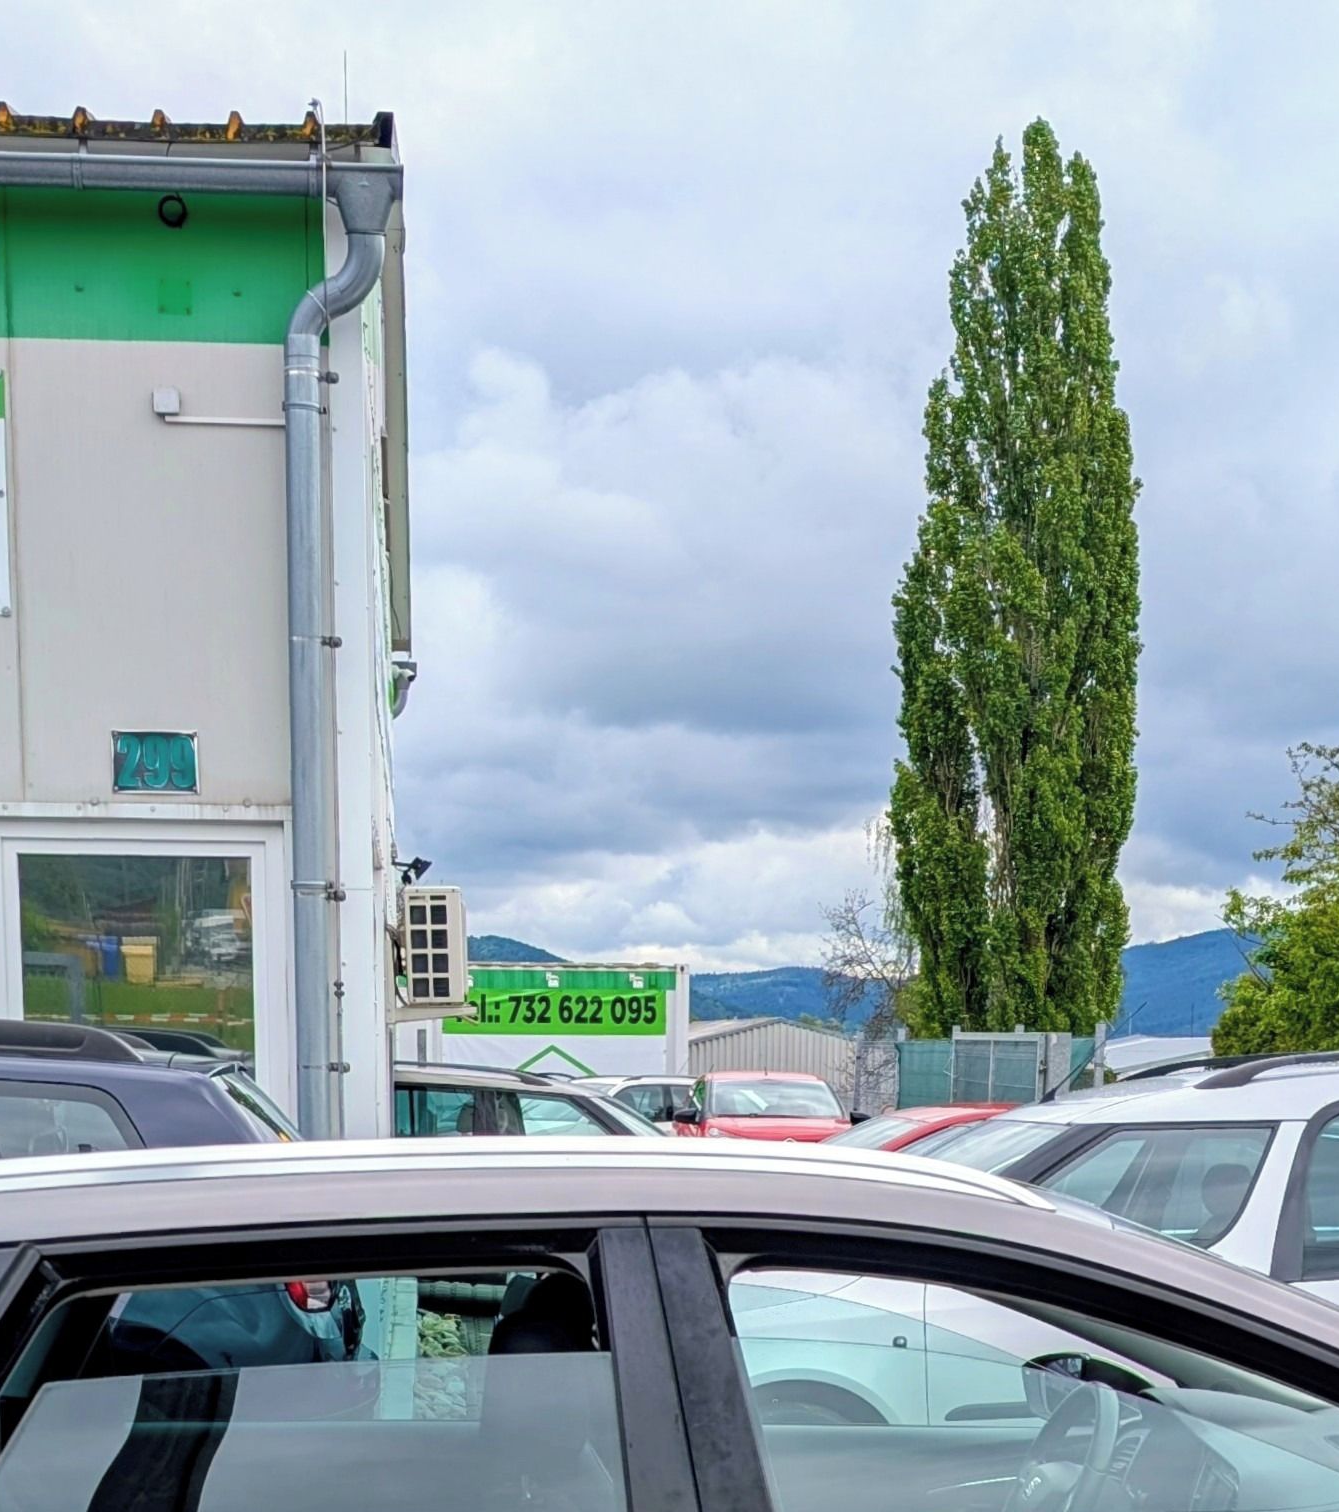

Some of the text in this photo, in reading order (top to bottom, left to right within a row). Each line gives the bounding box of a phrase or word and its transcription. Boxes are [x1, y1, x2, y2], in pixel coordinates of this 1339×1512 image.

[117, 734, 195, 788] 299
[508, 994, 551, 1024] 732
[558, 995, 603, 1024] 622
[610, 995, 657, 1025] 095
